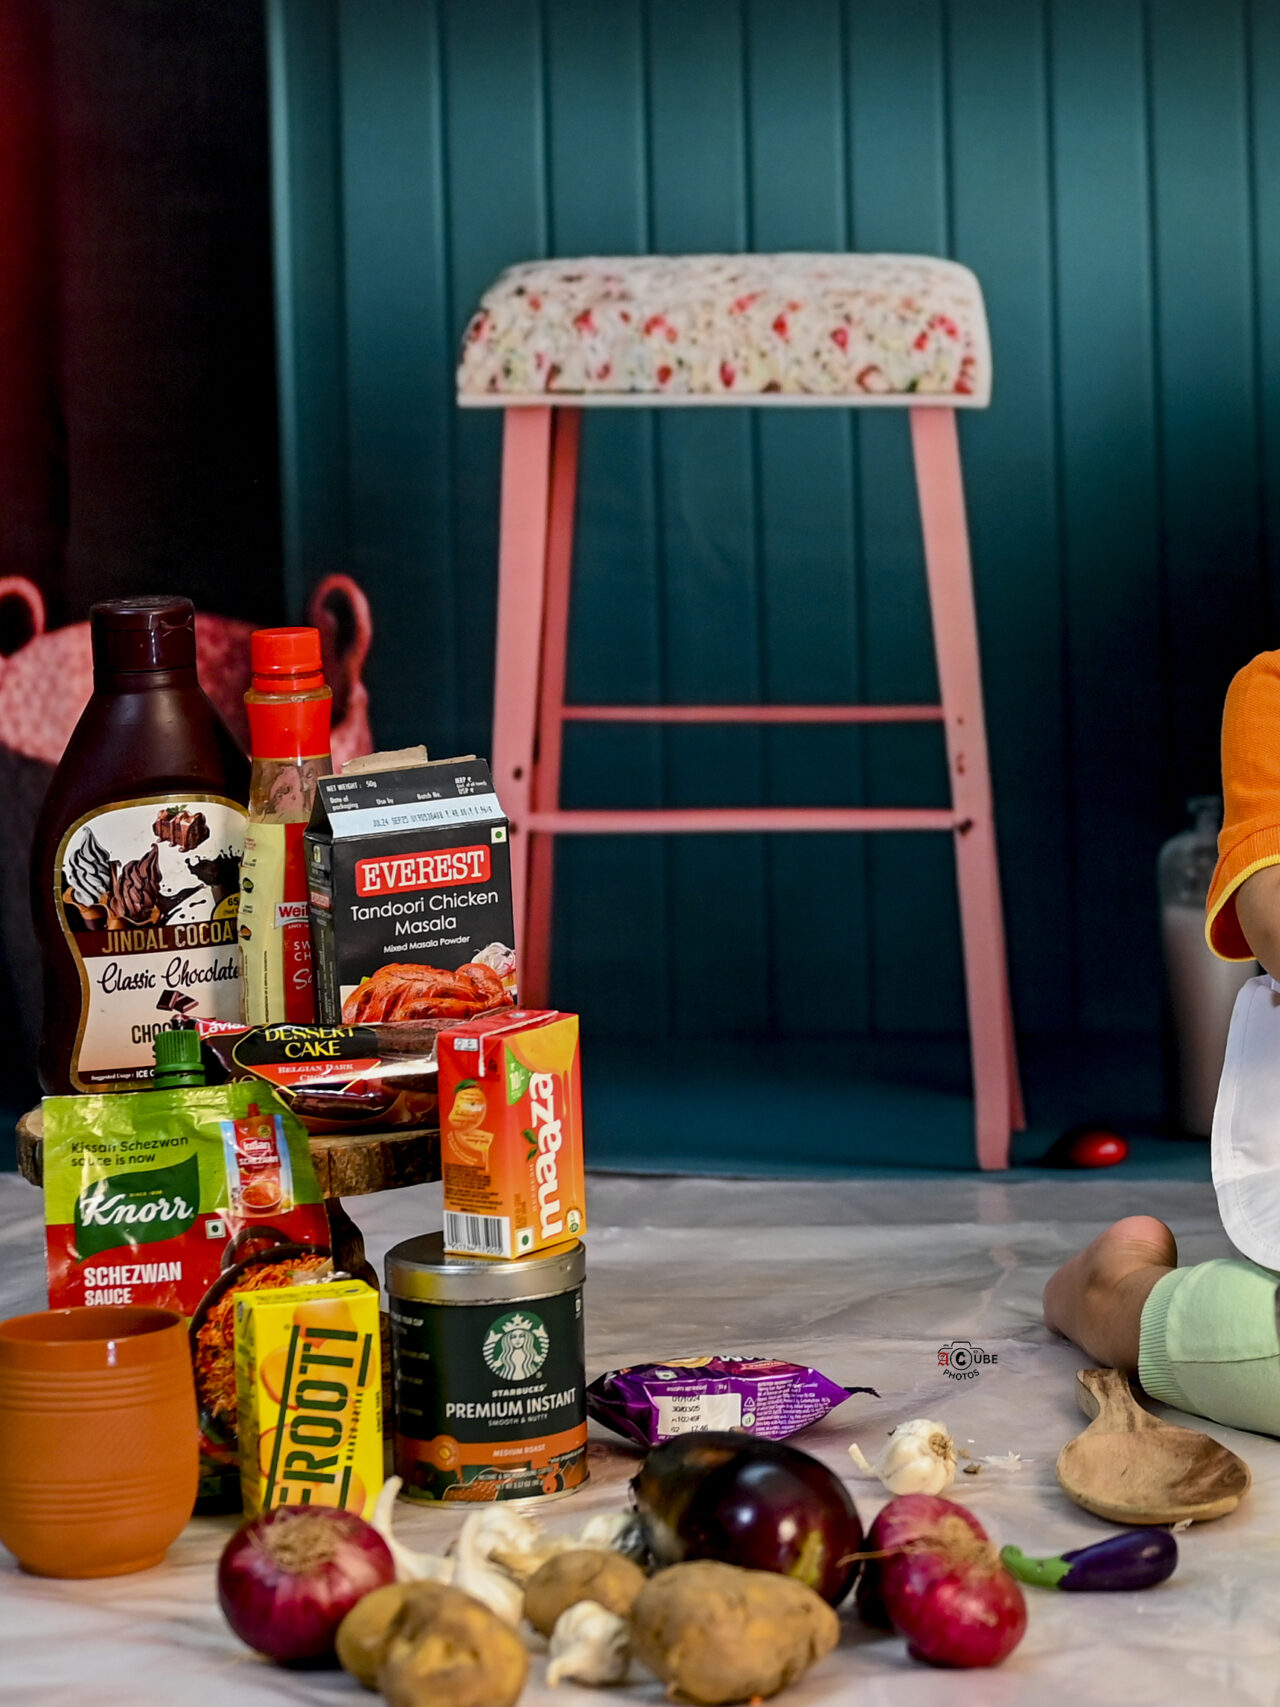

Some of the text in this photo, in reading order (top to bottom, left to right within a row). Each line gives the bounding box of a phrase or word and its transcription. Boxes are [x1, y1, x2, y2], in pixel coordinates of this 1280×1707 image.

[361, 850, 485, 891] EVEREST
[228, 896, 240, 906] 65
[350, 897, 424, 921] Tandoori
[429, 890, 499, 912] Chicken
[395, 915, 457, 936] Masala
[102, 928, 169, 954] JINDAL
[384, 935, 470, 954] Mixed Masala Powder
[97, 962, 156, 994] Classic
[160, 957, 239, 988] Chocolate
[264, 1026, 354, 1042] DESSERT
[284, 1040, 342, 1058] CAKE
[136, 1070, 148, 1078] ICE
[278, 1064, 353, 1074] BELGIAN DARK
[71, 1136, 188, 1154] Kissan Schezwan
[71, 1152, 156, 1168] sauce is now
[529, 1072, 563, 1240] maaza
[81, 1194, 194, 1228] Knorr
[84, 1260, 182, 1288] SCHEZWAN
[84, 1288, 133, 1306] SAUCE
[492, 1384, 546, 1398] STARBUCKS
[445, 1400, 522, 1419] PREMIUM
[526, 1388, 576, 1412] INSTANT
[488, 1418, 519, 1427] SMOOTH
[528, 1414, 548, 1422] NUTTY
[492, 1444, 546, 1458] MEDIUM ROAST
